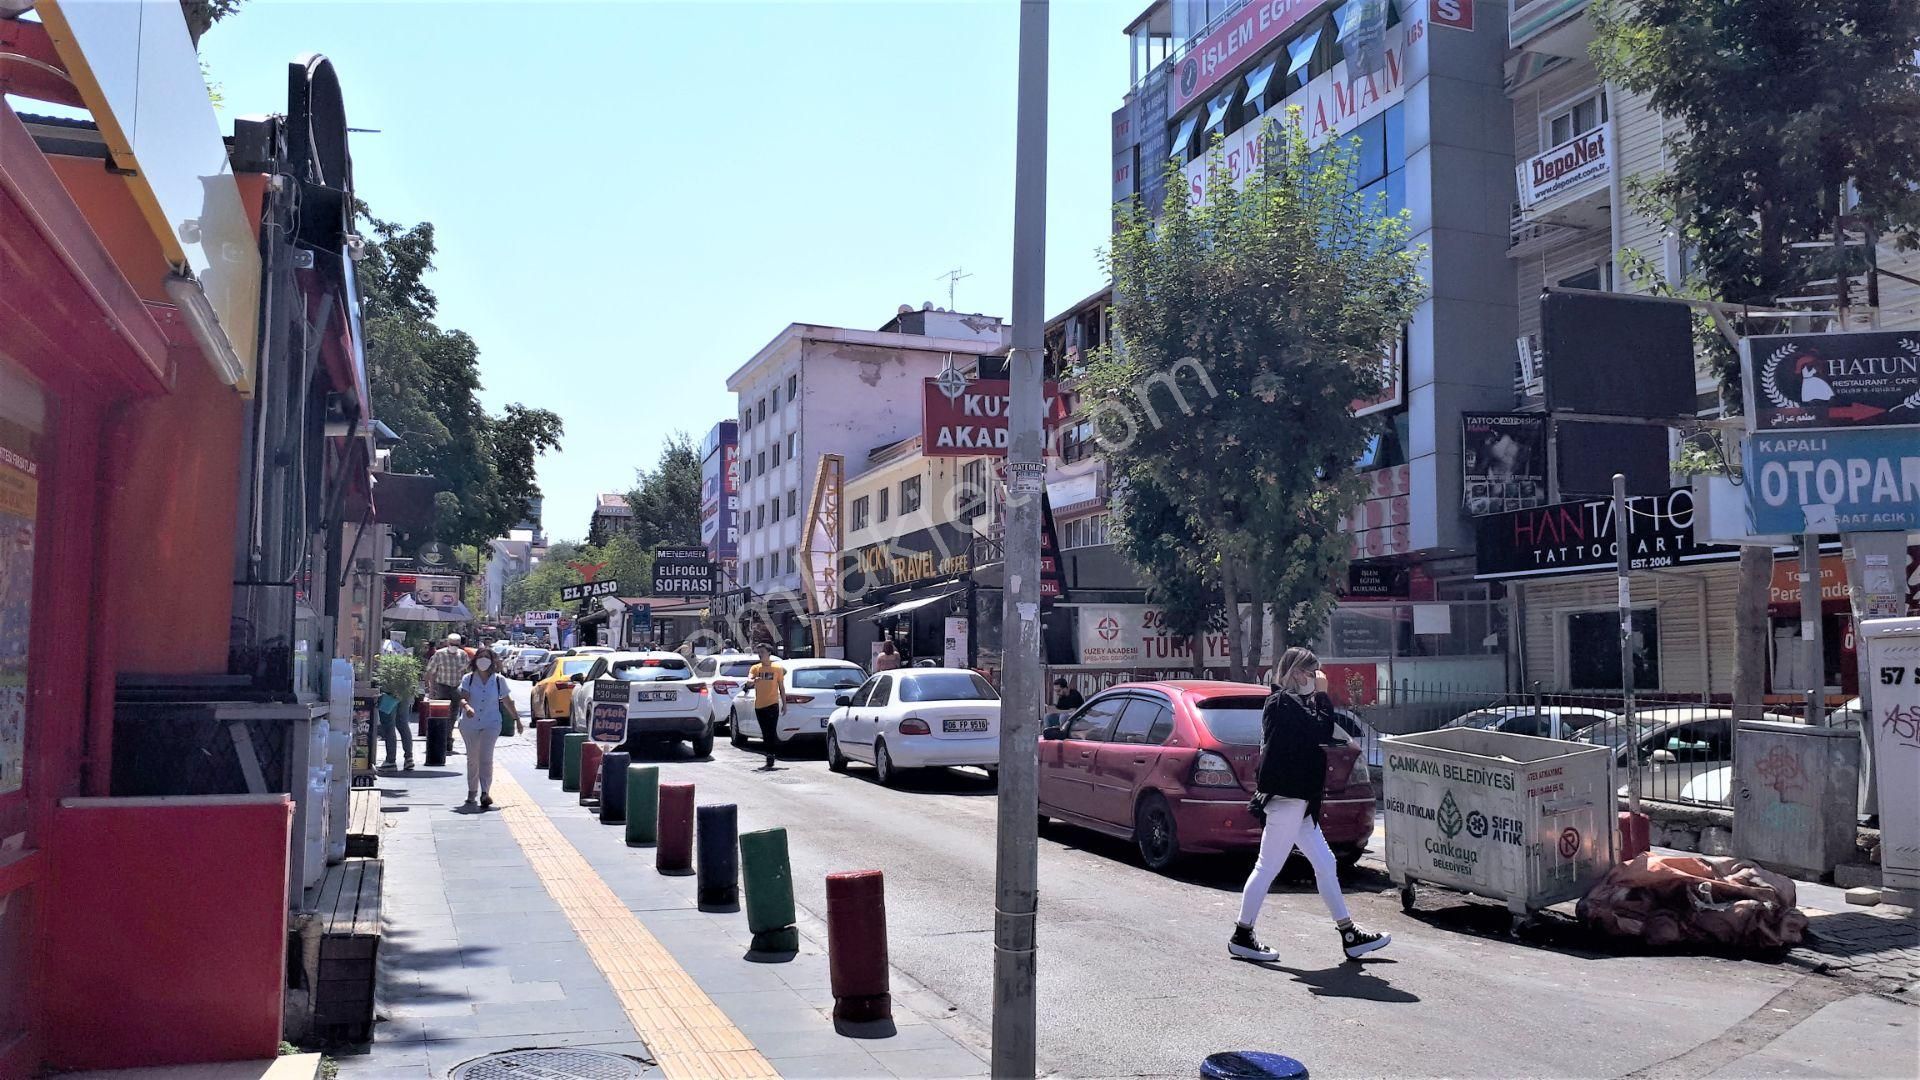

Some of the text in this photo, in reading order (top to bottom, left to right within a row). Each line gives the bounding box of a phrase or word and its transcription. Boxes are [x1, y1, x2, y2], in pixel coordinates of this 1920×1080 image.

[1201, 17, 1254, 77] İŞLEM
[1532, 133, 1606, 187] DepoNet
[1827, 356, 1918, 376] HATUN
[1832, 379, 1888, 387] RESTAURANT
[1895, 377, 1918, 385] CAFE
[963, 394, 1056, 418] KUY
[1759, 438, 1827, 453] KAPALI
[657, 550, 706, 558] MENEMEN
[1631, 556, 1671, 569] EST. 2004
[659, 564, 708, 576] ELİFOĞLU
[891, 549, 937, 583] TRAVEL
[939, 554, 968, 575] COFFEE
[563, 580, 617, 600] EL PASO
[655, 578, 712, 592] SOFRASI
[1143, 629, 1231, 659] TÜRKYE
[1880, 667, 1905, 685] 57
[1389, 754, 1441, 777] ÇANKAYA
[1443, 764, 1515, 791] BELEDİYESİ
[1386, 797, 1436, 821] DİĞER ATIKLAR
[1493, 830, 1522, 846] ATIK
[1424, 837, 1478, 864] Çankaya
[1433, 858, 1472, 876] BELEDİYESİ
